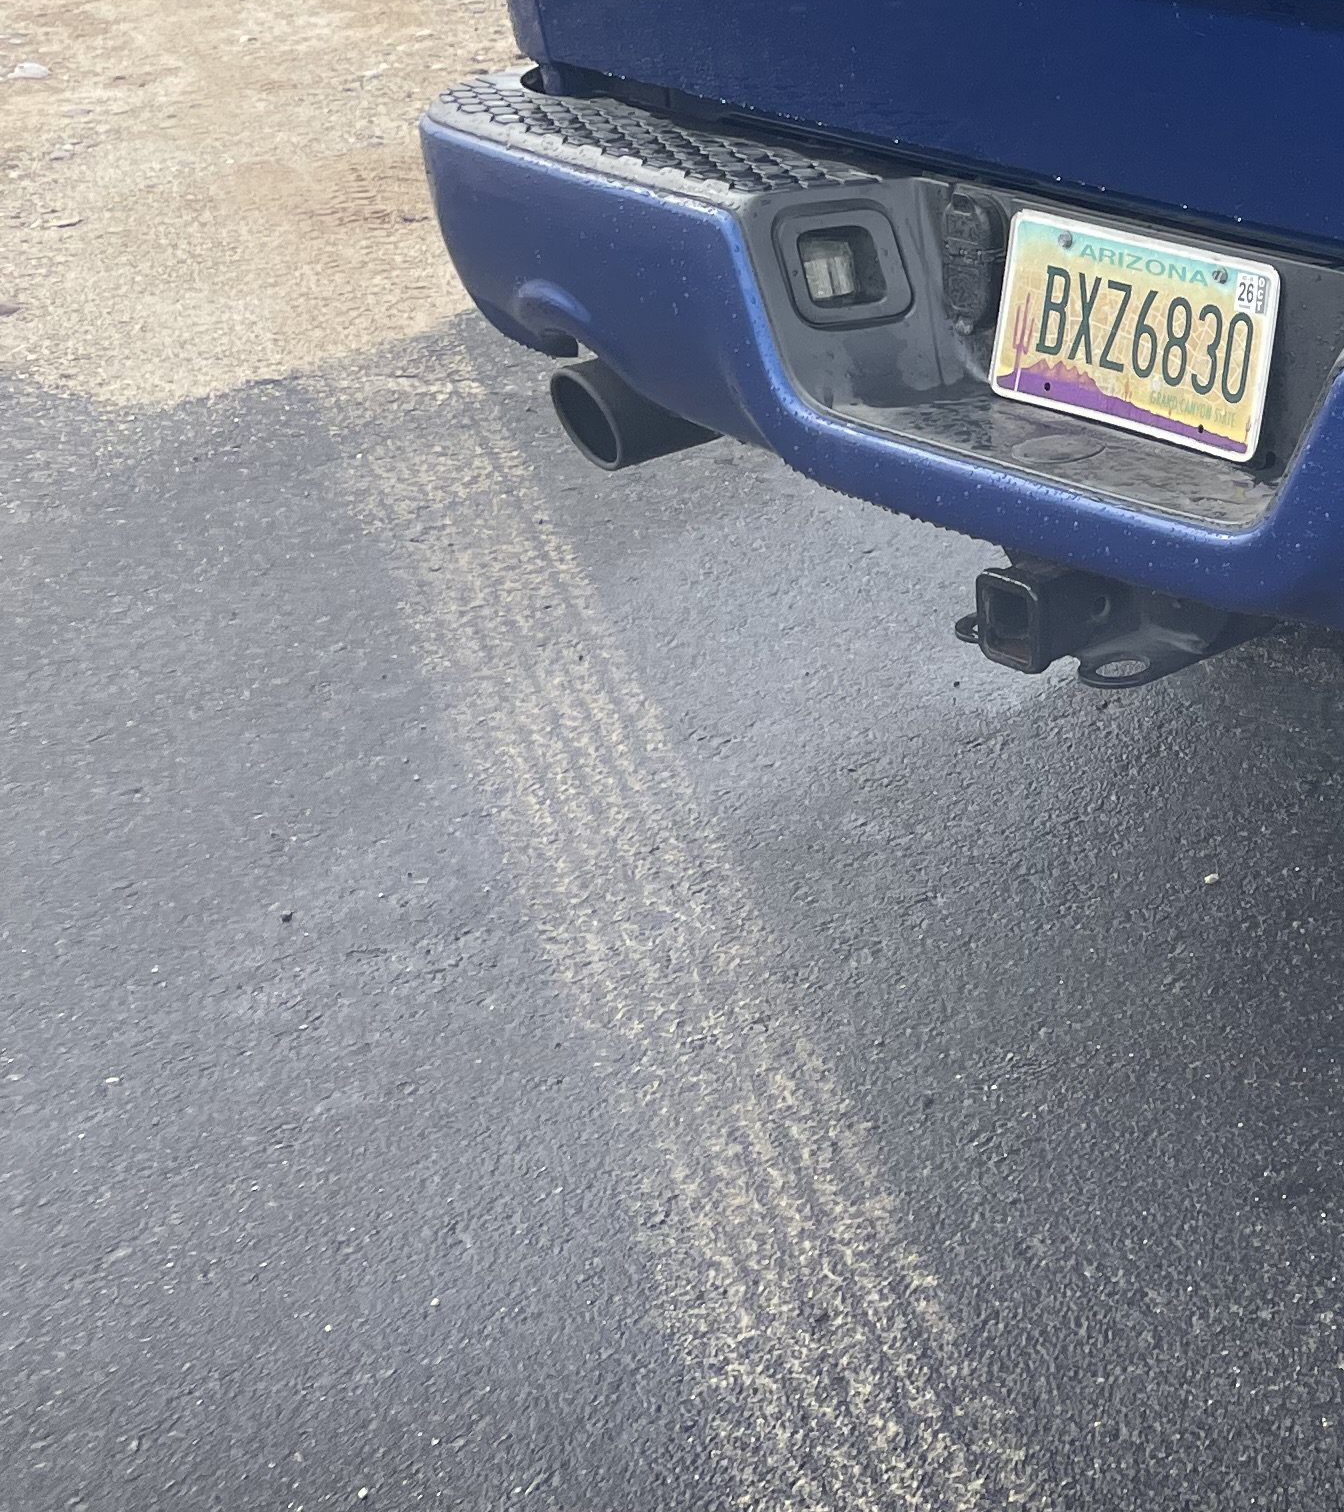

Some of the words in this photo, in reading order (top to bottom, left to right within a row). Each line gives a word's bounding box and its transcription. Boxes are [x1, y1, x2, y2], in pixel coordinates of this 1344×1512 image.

[1080, 244, 1208, 287] ARIZONA
[1237, 281, 1254, 304] 26
[1036, 265, 1254, 404] BXZ6830
